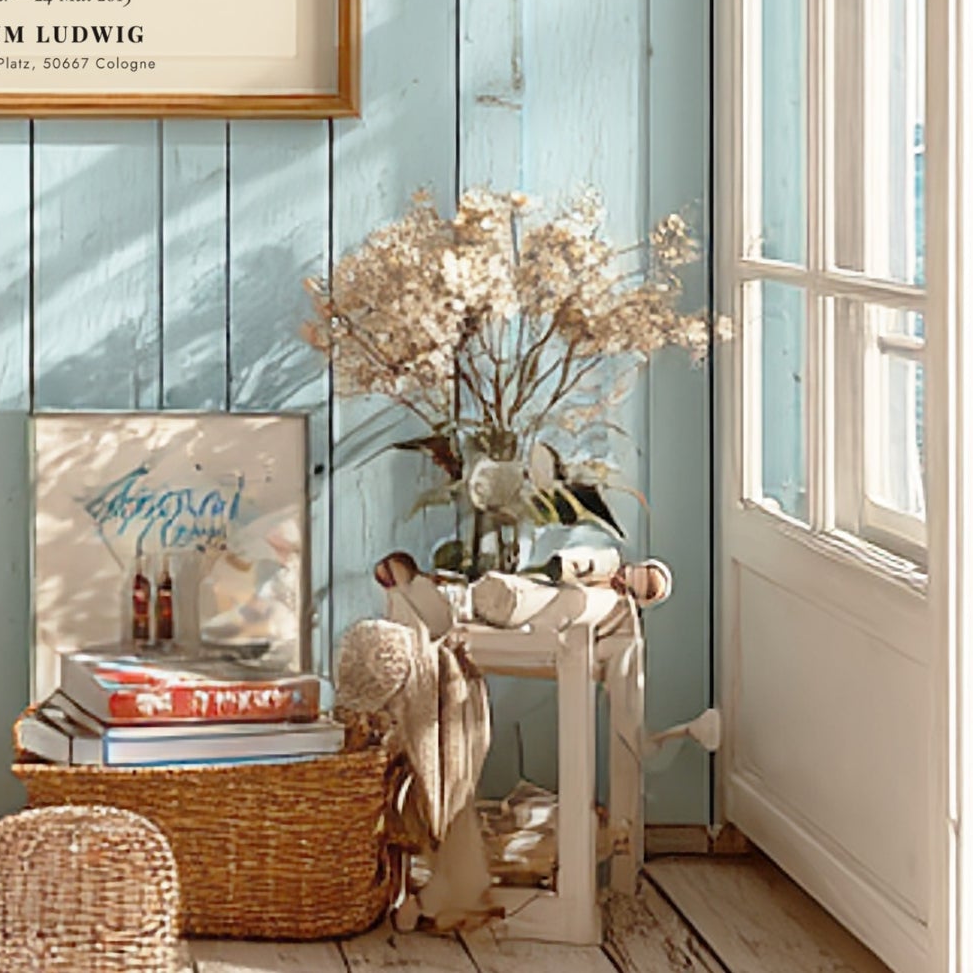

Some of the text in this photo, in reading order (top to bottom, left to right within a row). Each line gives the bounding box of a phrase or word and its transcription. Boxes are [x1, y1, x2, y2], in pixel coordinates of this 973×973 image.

[36, 25, 144, 44] LUDWIG
[42, 57, 90, 70] 50667
[95, 56, 156, 73] Cologne
